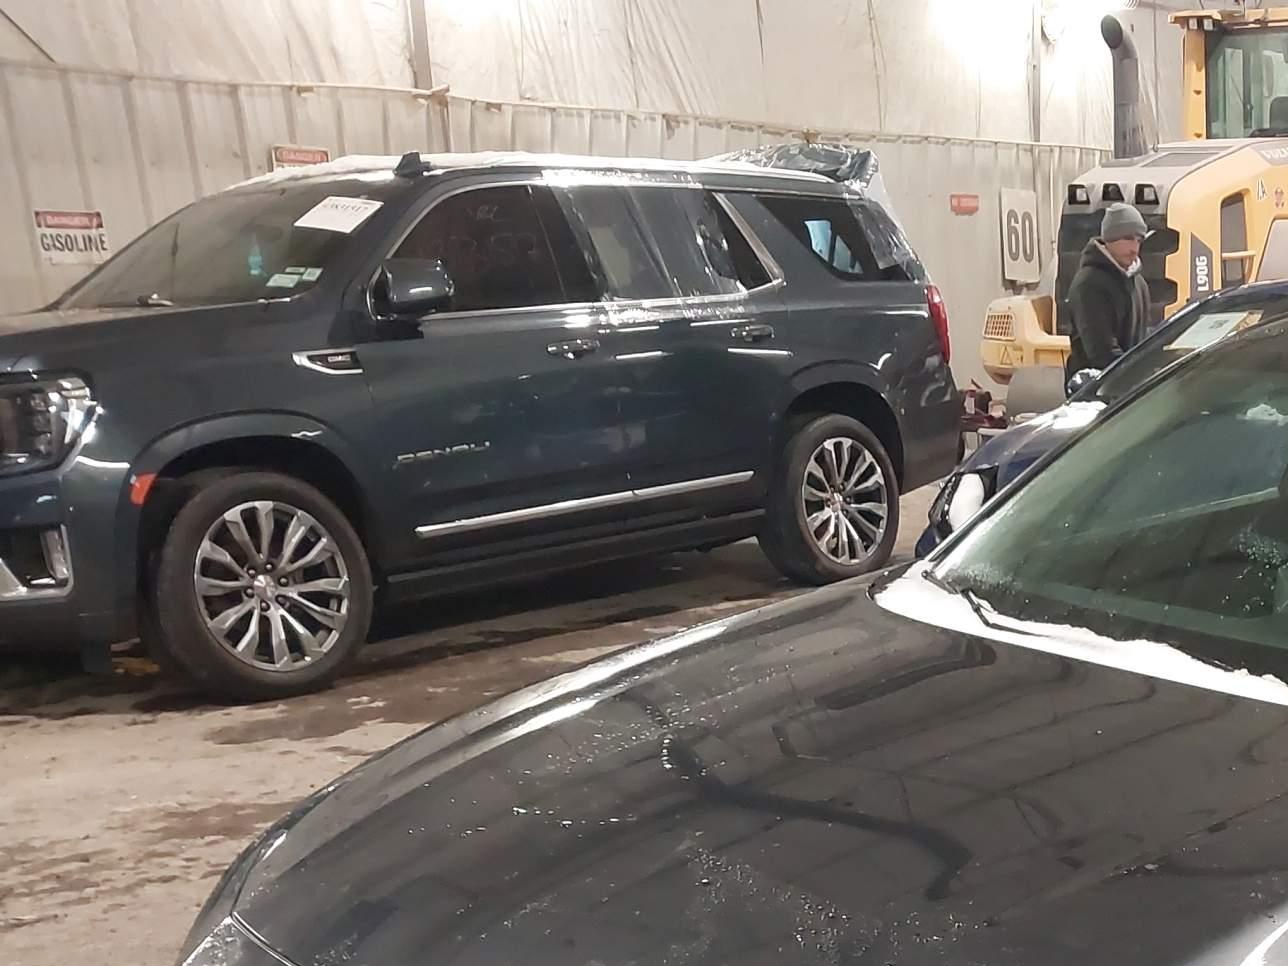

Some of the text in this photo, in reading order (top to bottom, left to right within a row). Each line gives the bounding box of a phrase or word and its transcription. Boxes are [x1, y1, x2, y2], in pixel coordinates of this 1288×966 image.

[40, 232, 108, 252] GASOLINE
[1006, 208, 1034, 263] 60
[1195, 255, 1210, 292] L90G
